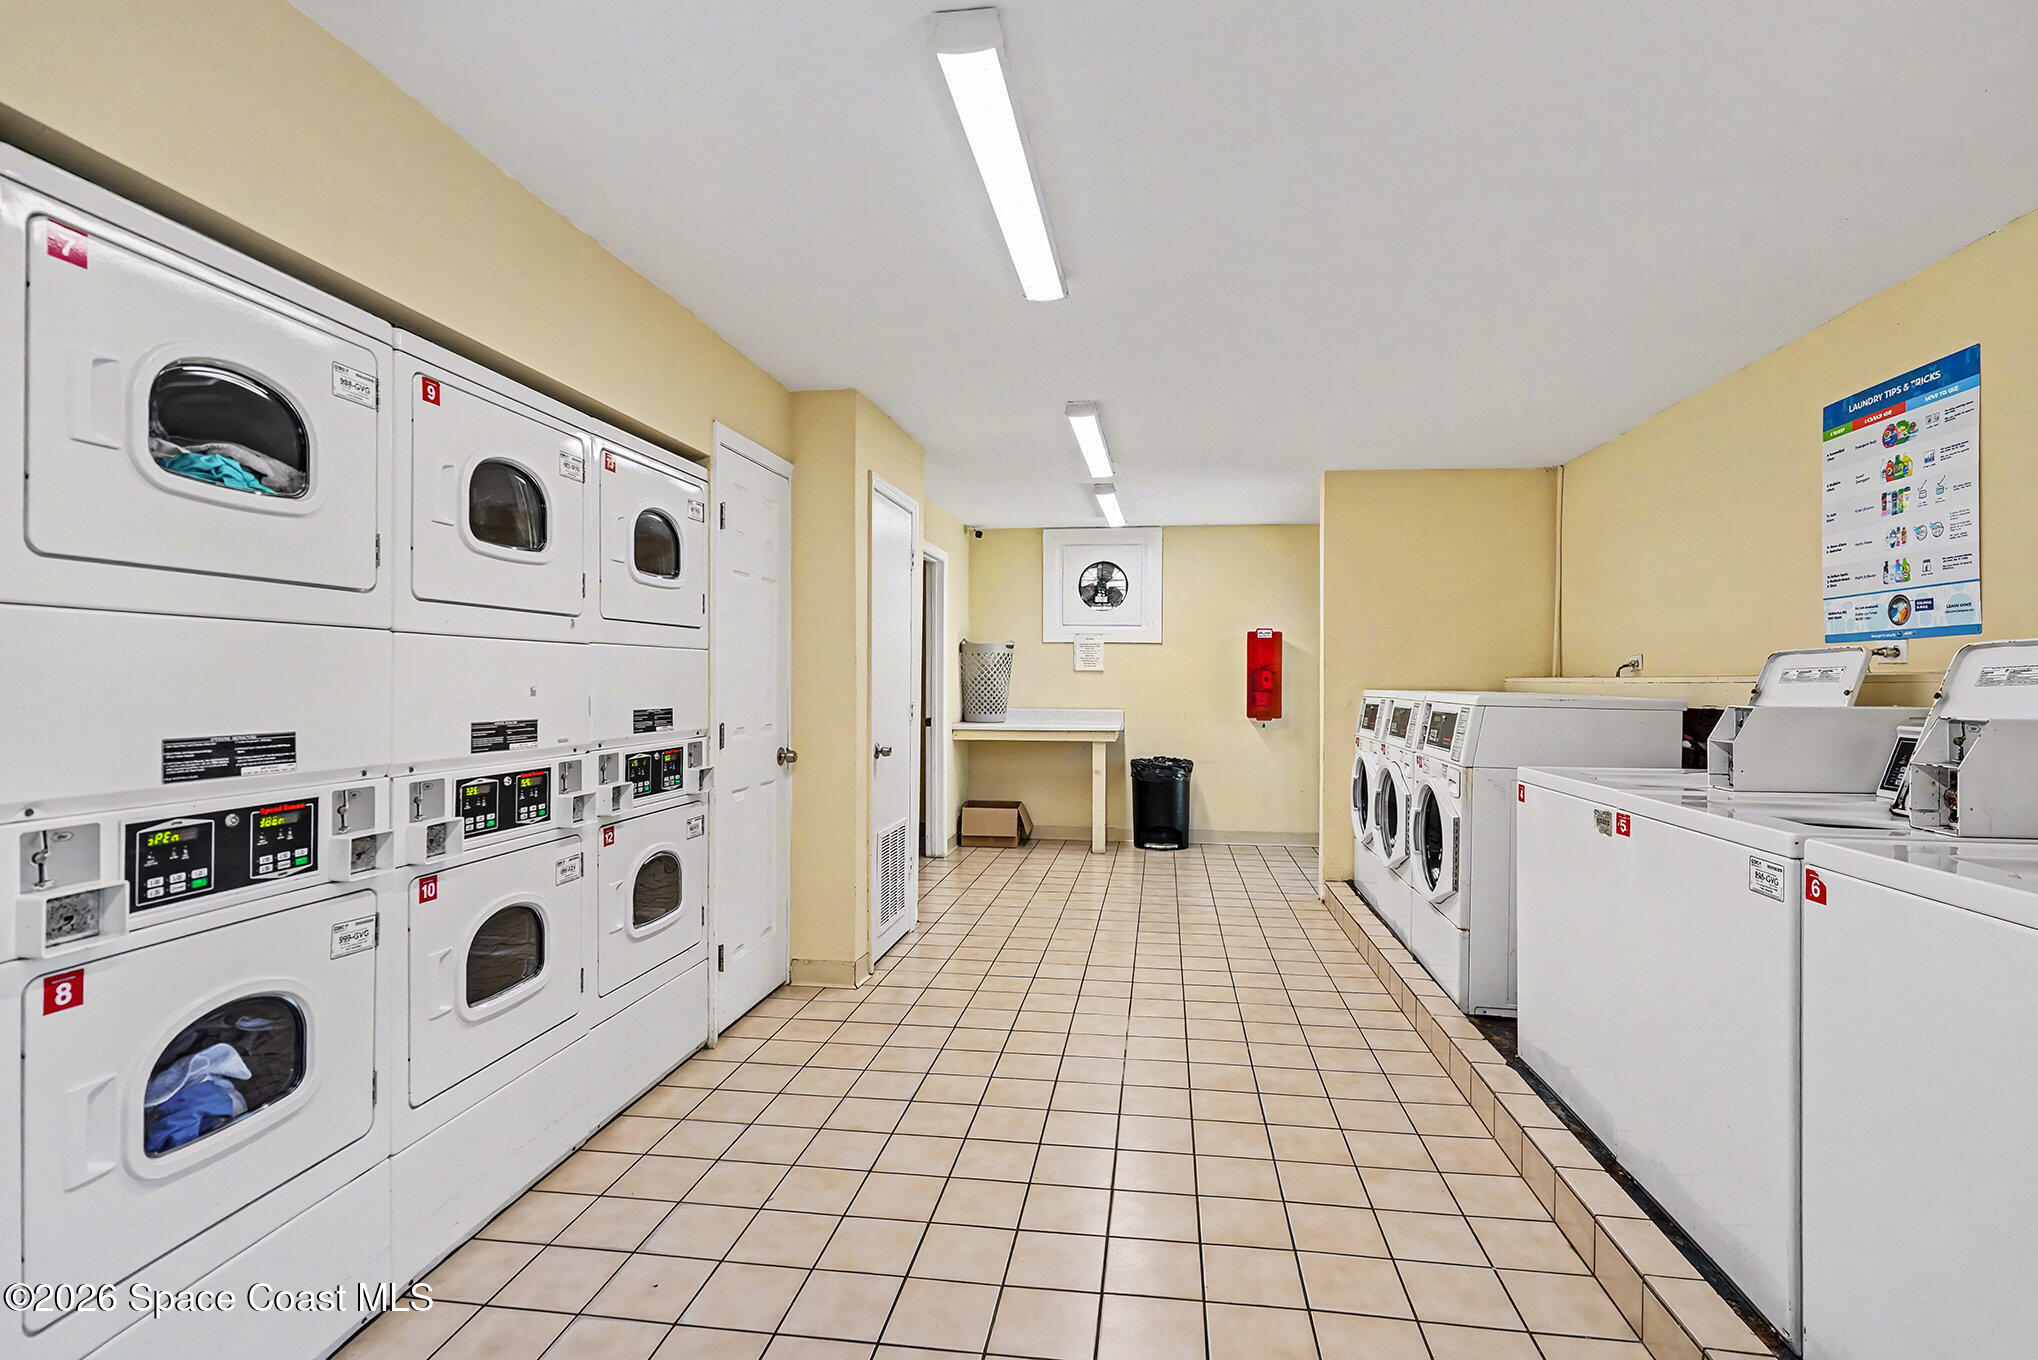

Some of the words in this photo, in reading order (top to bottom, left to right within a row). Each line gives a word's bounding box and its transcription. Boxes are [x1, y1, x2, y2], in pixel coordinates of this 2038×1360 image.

[427, 385, 436, 400] 9
[1849, 392, 1883, 413] LAUNDRY
[1883, 385, 1902, 399] TIPS
[1903, 382, 1910, 392] &
[1910, 370, 1942, 388] TRICKS
[1618, 819, 1627, 833] 5
[604, 831, 613, 844] 12
[422, 883, 435, 899] 10
[1811, 879, 1820, 898] 6
[55, 982, 72, 1005] 8
